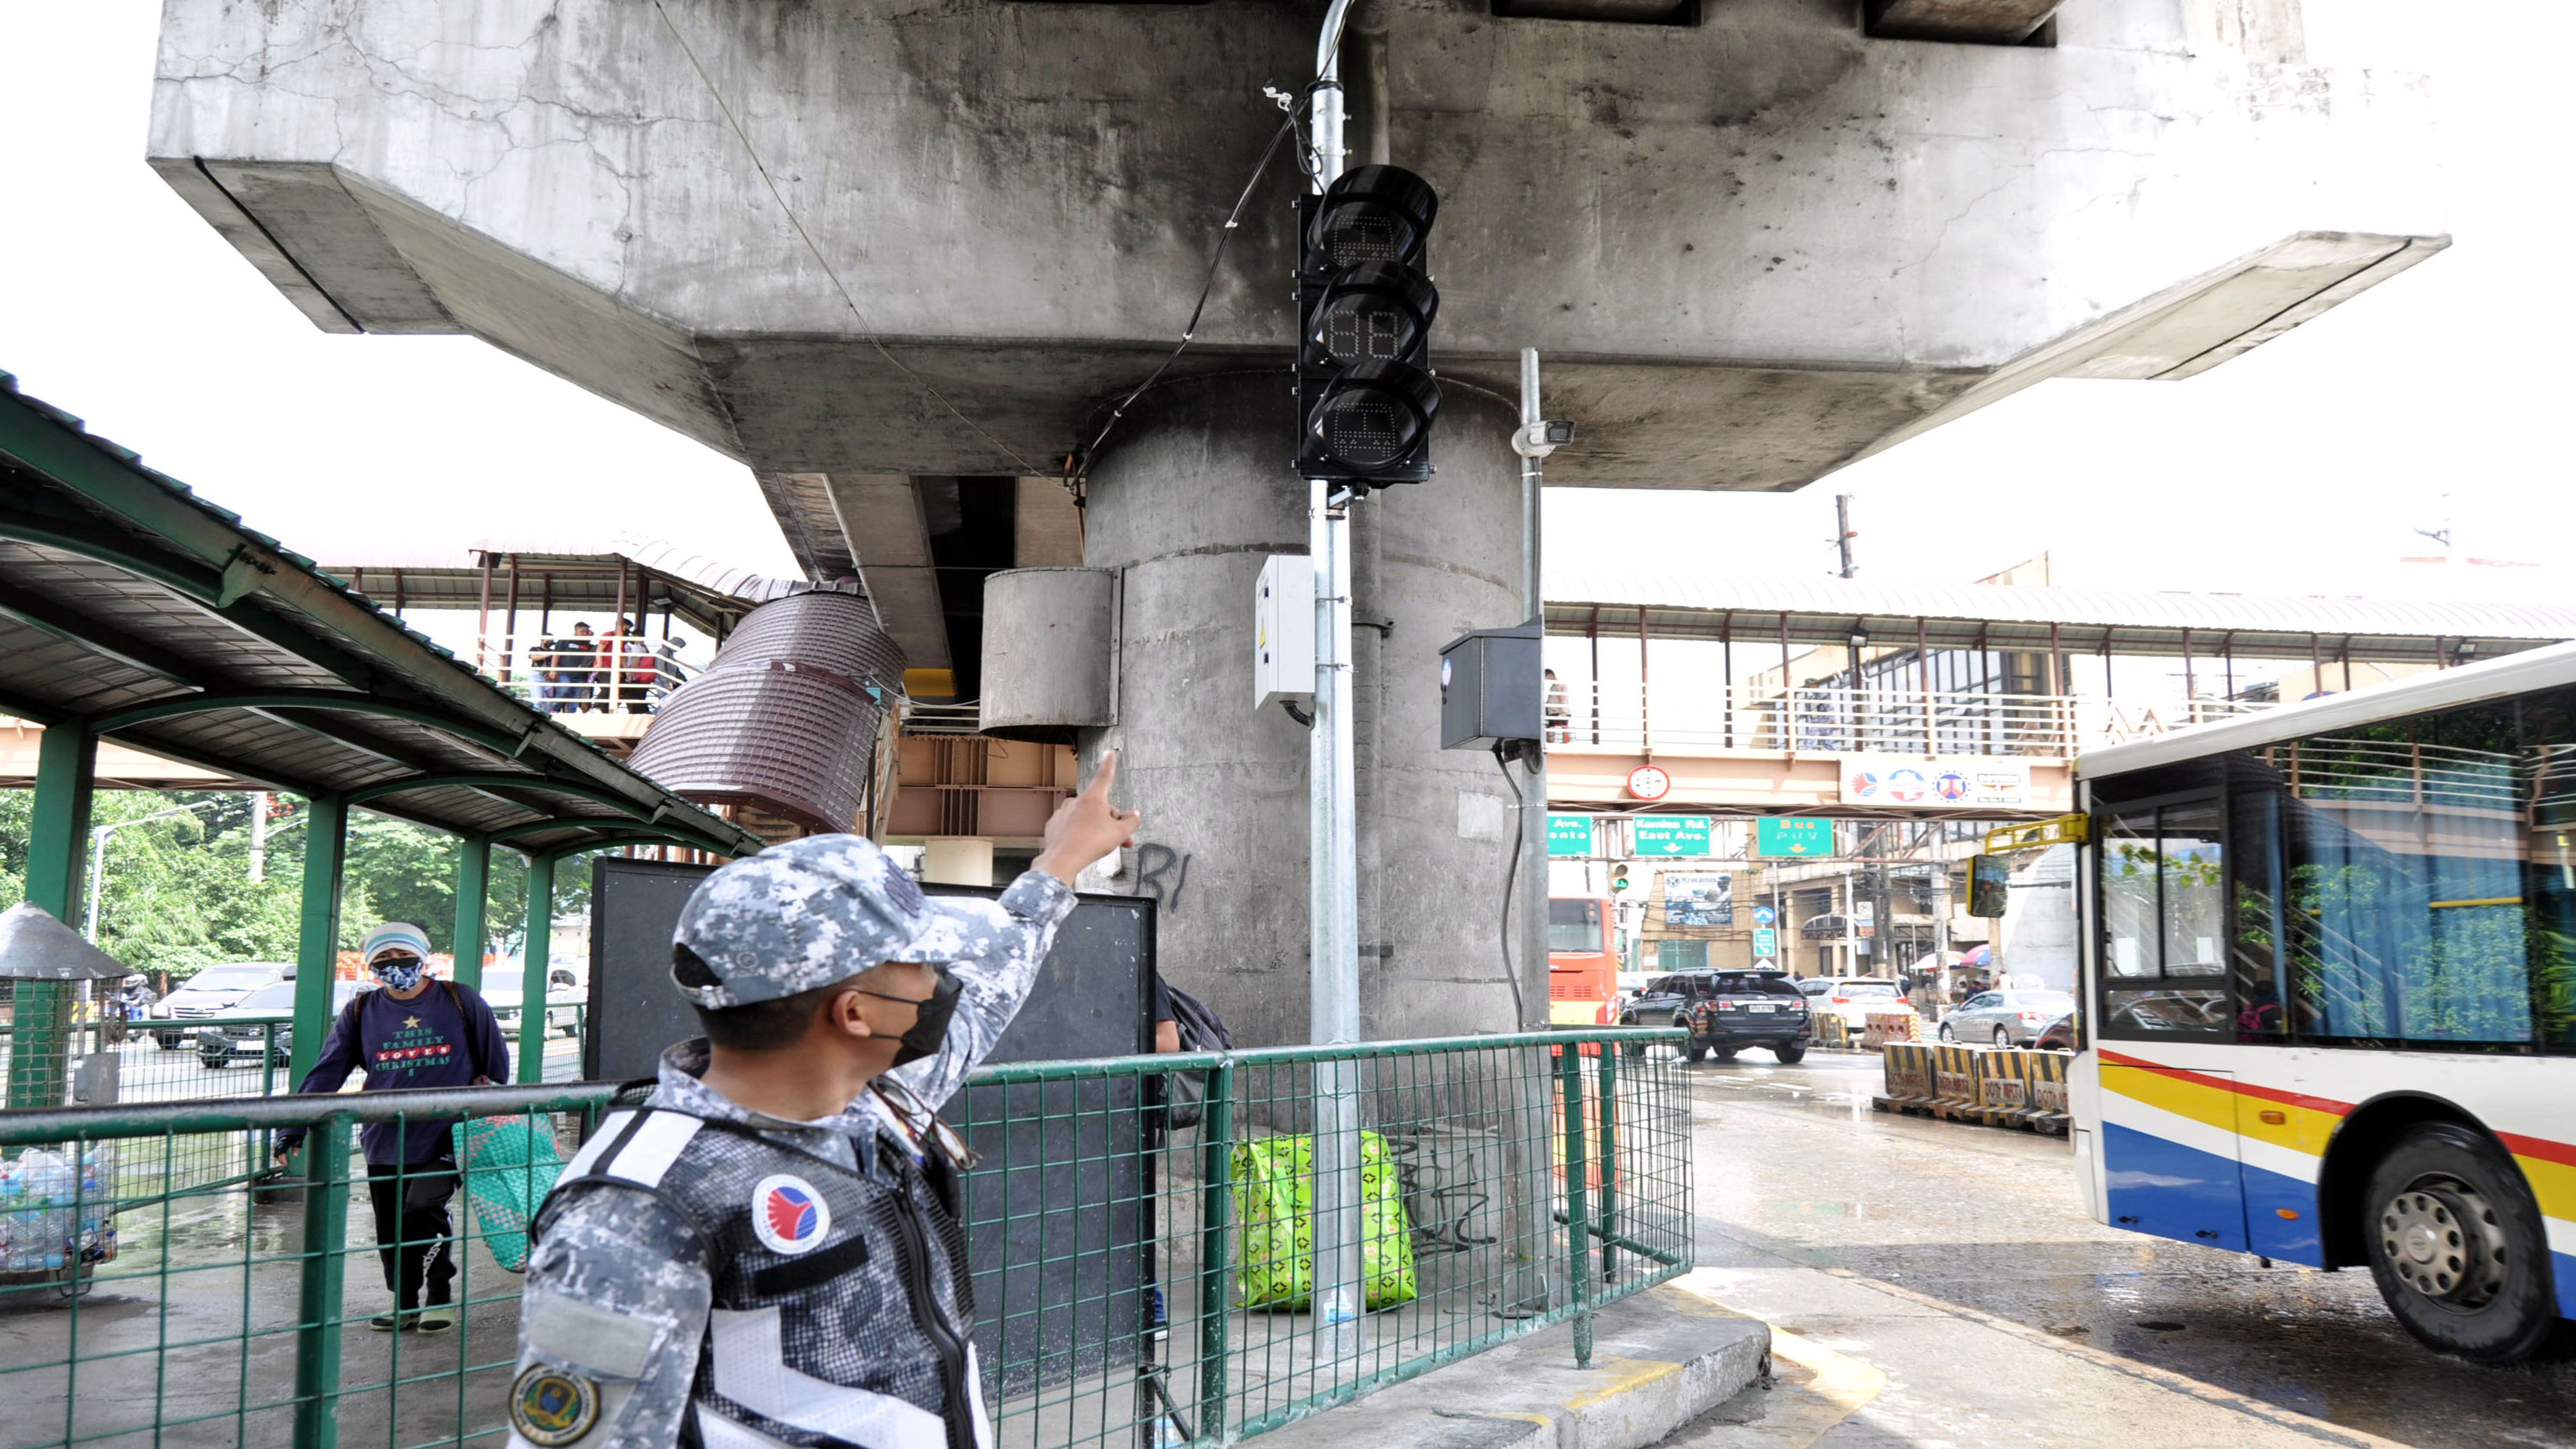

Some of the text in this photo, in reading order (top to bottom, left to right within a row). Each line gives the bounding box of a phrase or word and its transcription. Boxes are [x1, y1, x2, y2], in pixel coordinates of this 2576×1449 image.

[1554, 818, 1583, 828] Ave.
[1781, 819, 1815, 829] Bus
[1638, 830, 1706, 840] East Ave.
[392, 1027, 433, 1039] THIS
[382, 1035, 445, 1050] FAMILY
[378, 1046, 449, 1061] LOVES
[375, 1056, 451, 1071] CHRISTMAS
